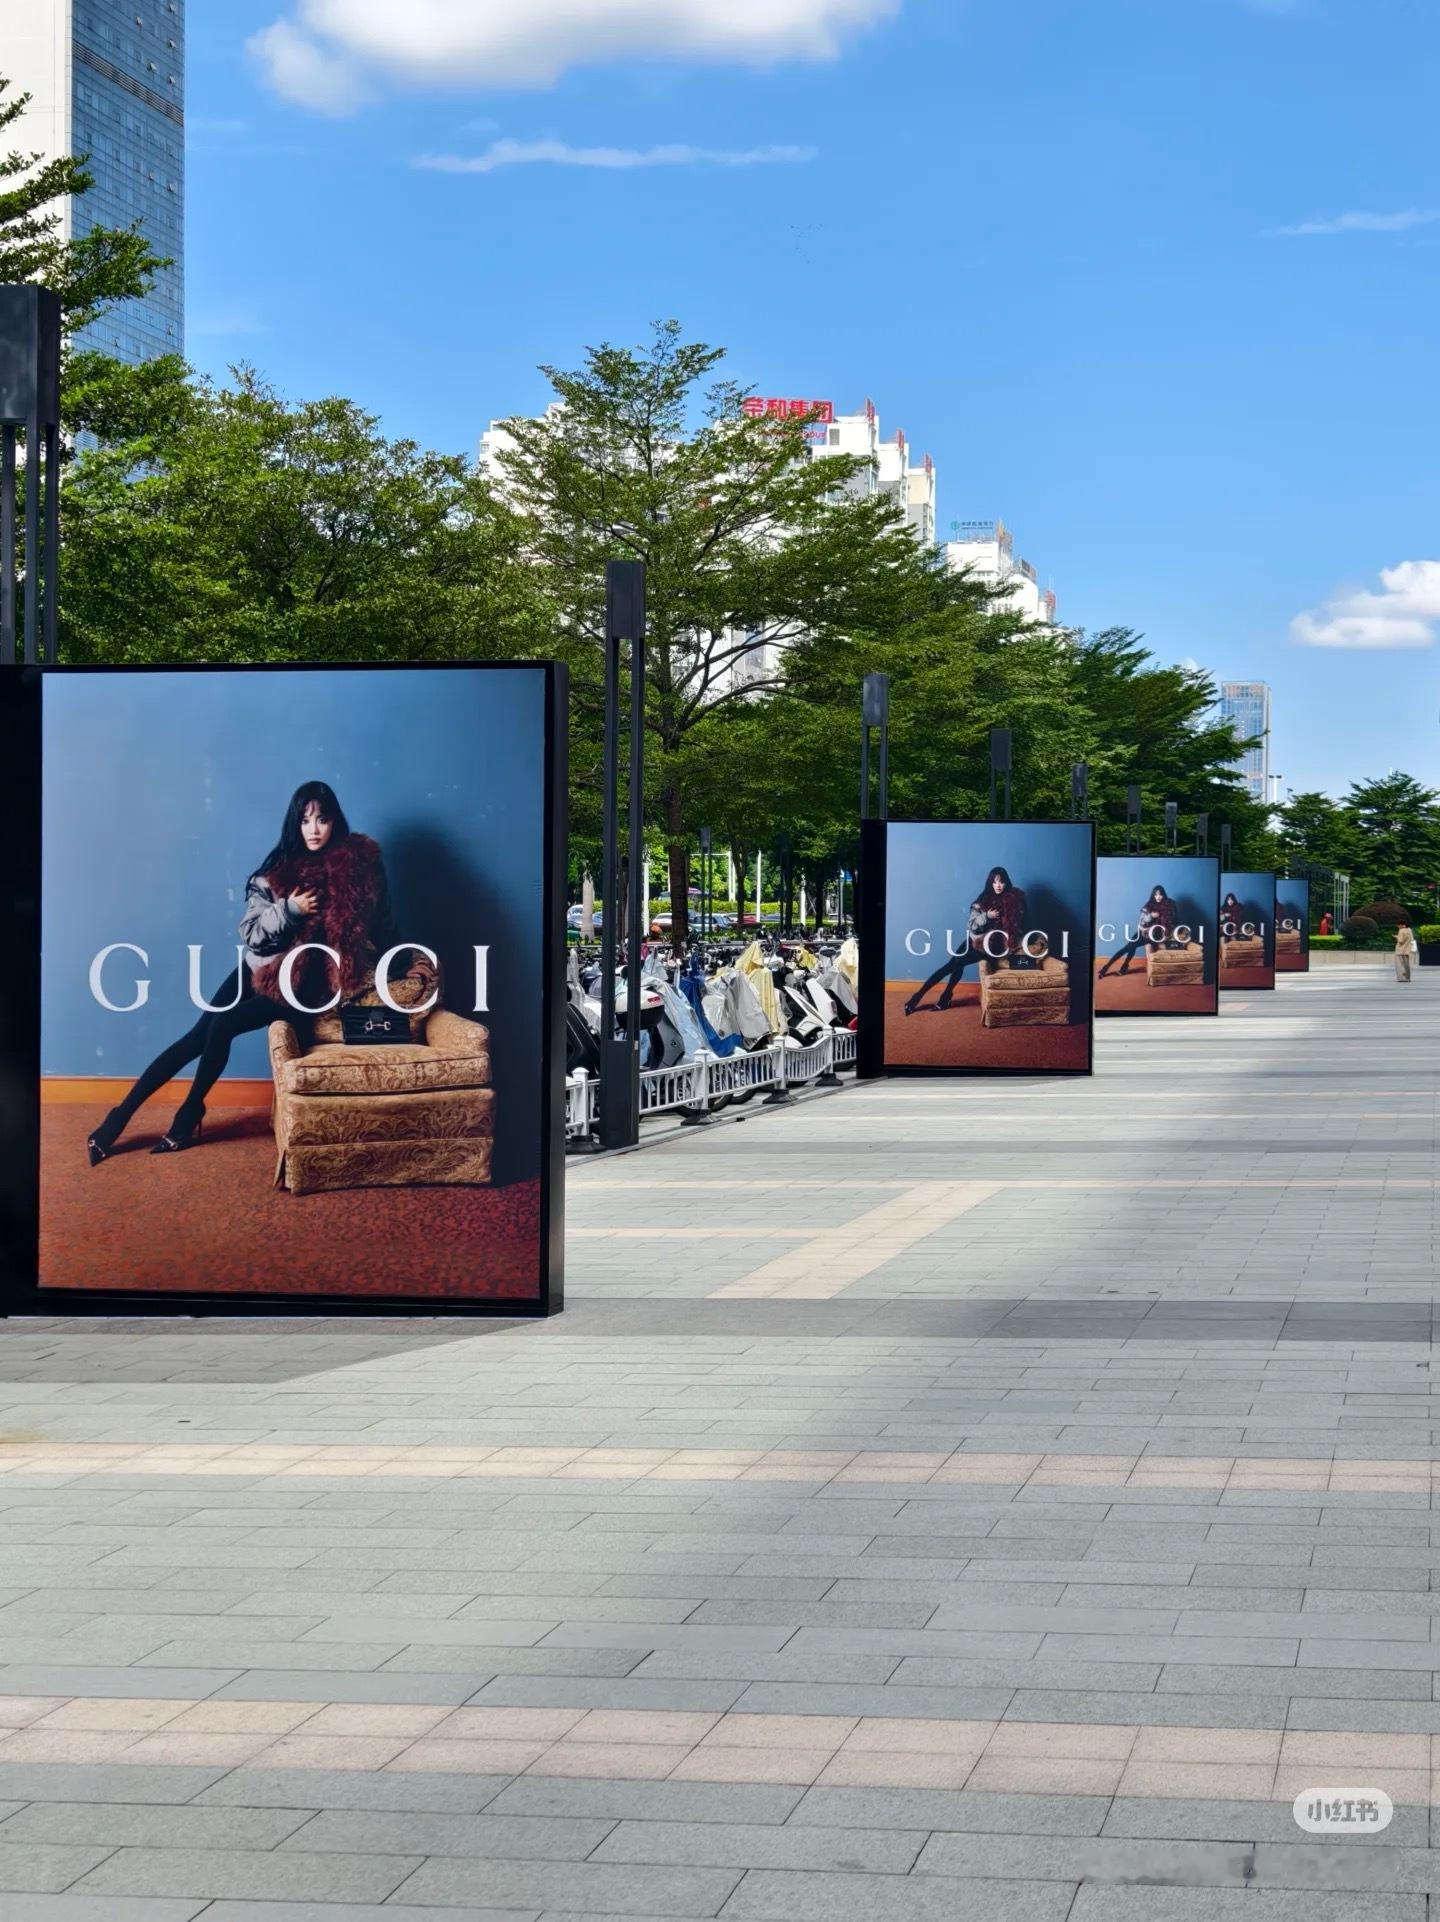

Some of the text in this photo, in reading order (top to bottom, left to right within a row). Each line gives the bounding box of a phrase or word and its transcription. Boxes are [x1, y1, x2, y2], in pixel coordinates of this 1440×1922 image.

[1098, 923, 1204, 943] GUCCI
[1275, 918, 1301, 930] CI
[905, 928, 1069, 958] GUCCI
[88, 943, 491, 1013] GUCCI
